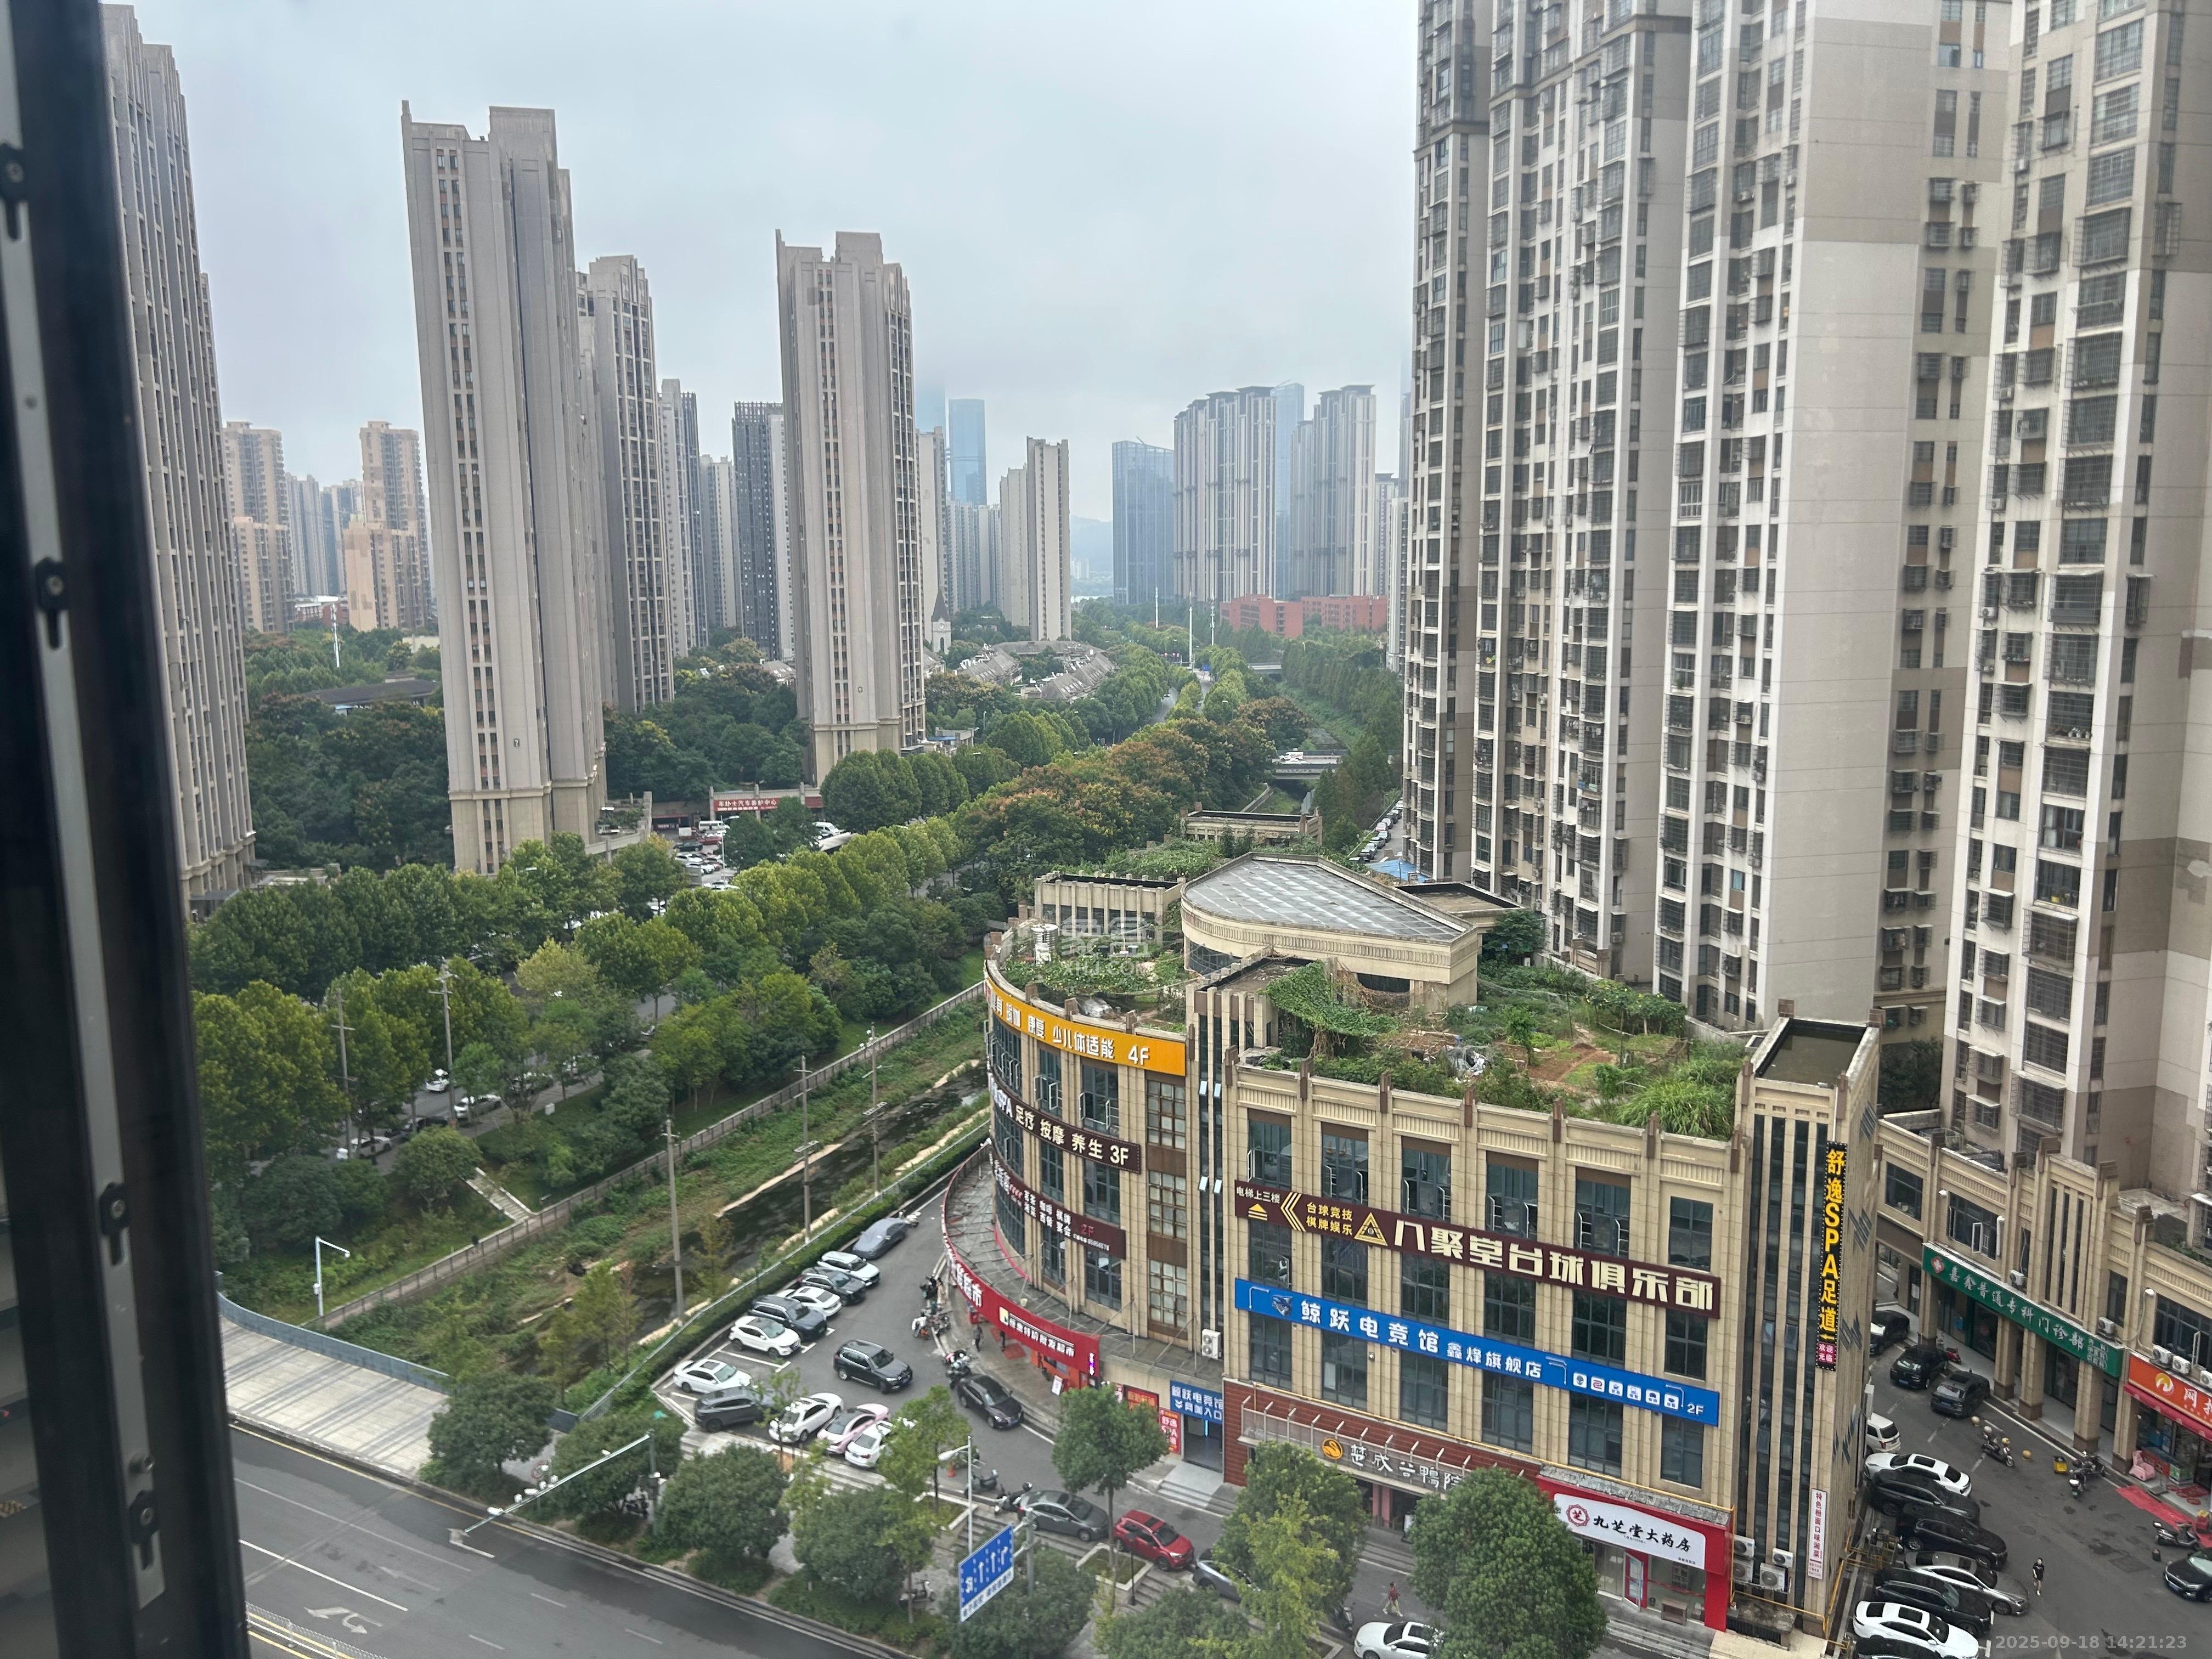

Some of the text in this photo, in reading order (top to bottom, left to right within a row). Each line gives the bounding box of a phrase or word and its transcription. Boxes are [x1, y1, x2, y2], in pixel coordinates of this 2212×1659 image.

[1053, 1025, 1115, 1059] 少儿体适能
[1127, 1045, 1150, 1065] 4F
[1040, 1118, 1065, 1145] 按摩
[1071, 1132, 1103, 1160] 养生
[1110, 1144, 1129, 1165] 3F
[1236, 1186, 1280, 1204] 电梯上三楼
[1307, 1202, 1353, 1221] 台球竞技
[1307, 1216, 1353, 1236] 棋牌娱乐
[1820, 1149, 1844, 1333] 舒逸SPA足道
[1301, 1300, 1440, 1353] 鲸跃电竞馆
[1687, 1403, 1705, 1415] 2F
[1594, 1515, 1691, 1552] 九芝堂大药房
